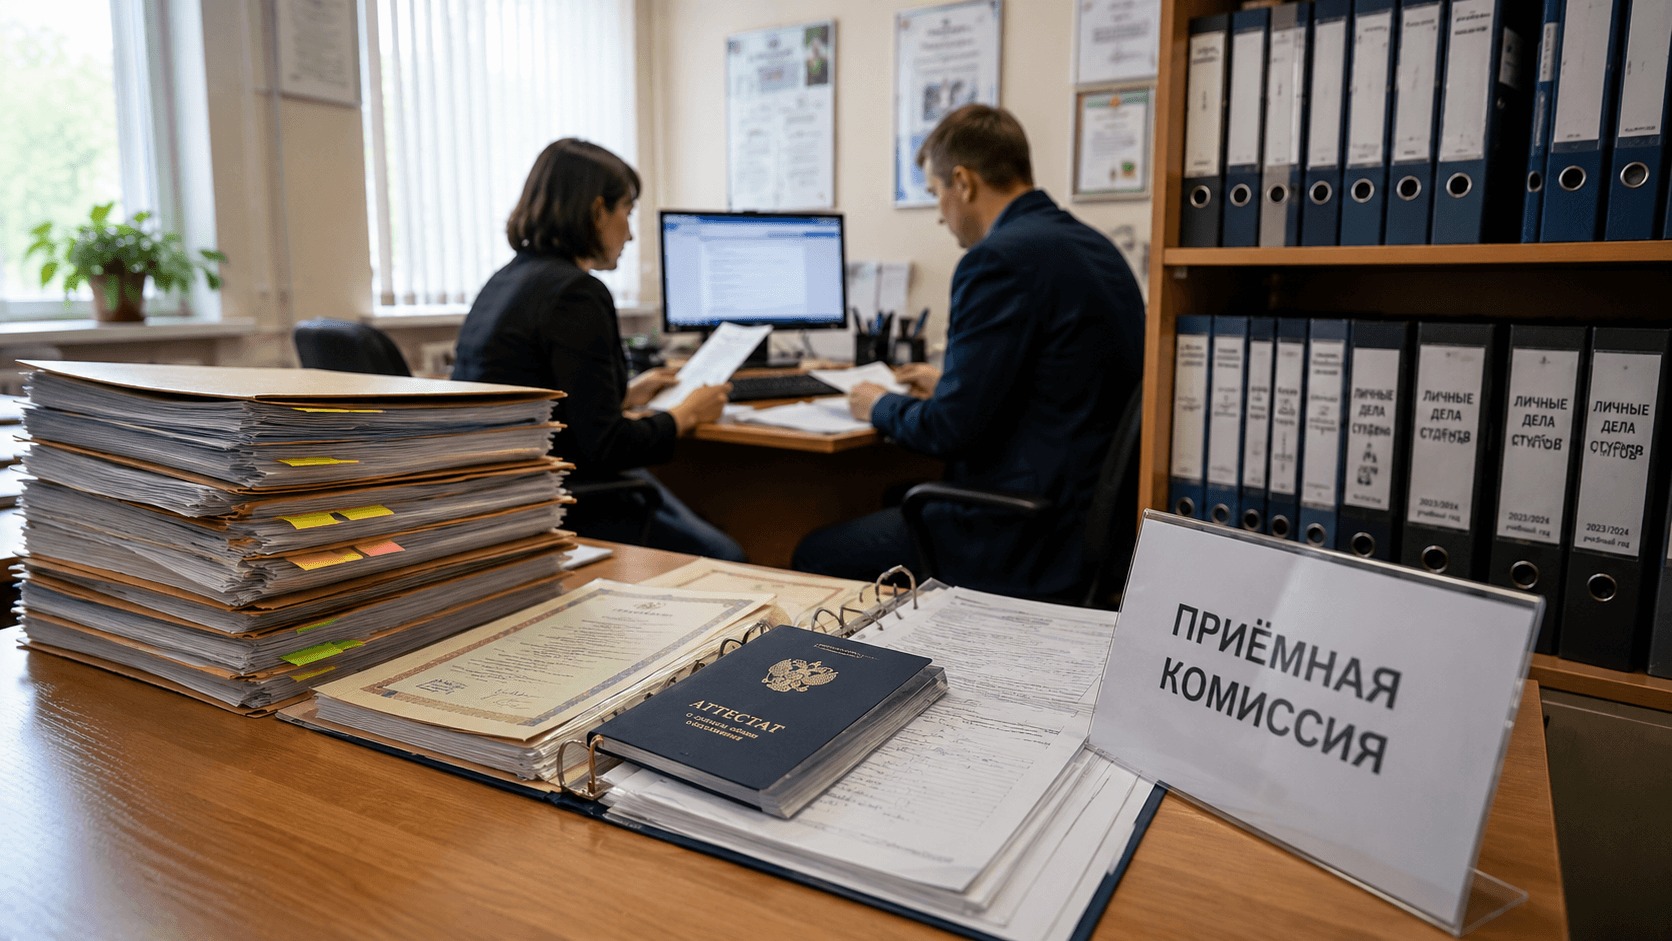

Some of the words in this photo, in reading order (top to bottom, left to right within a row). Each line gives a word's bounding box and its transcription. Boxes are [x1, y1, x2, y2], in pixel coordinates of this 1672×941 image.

[1423, 390, 1474, 405] ЛИЧНЫЕ
[1514, 396, 1568, 410] ЛИЧНЫЕ
[1359, 404, 1385, 417] ДЕЛА
[1430, 408, 1462, 421] ДЕЛА
[1593, 401, 1650, 416] ЛИЧНЫЕ
[1522, 414, 1555, 428] ДЕЛА
[1601, 420, 1636, 434] ДЕЛА
[1586, 523, 1629, 536] 2023/2024
[1172, 603, 1402, 710] ПРИЁМНАЯ
[688, 700, 786, 733] АТТЕСТАТ
[1159, 657, 1388, 775] КОМИССИЯ
